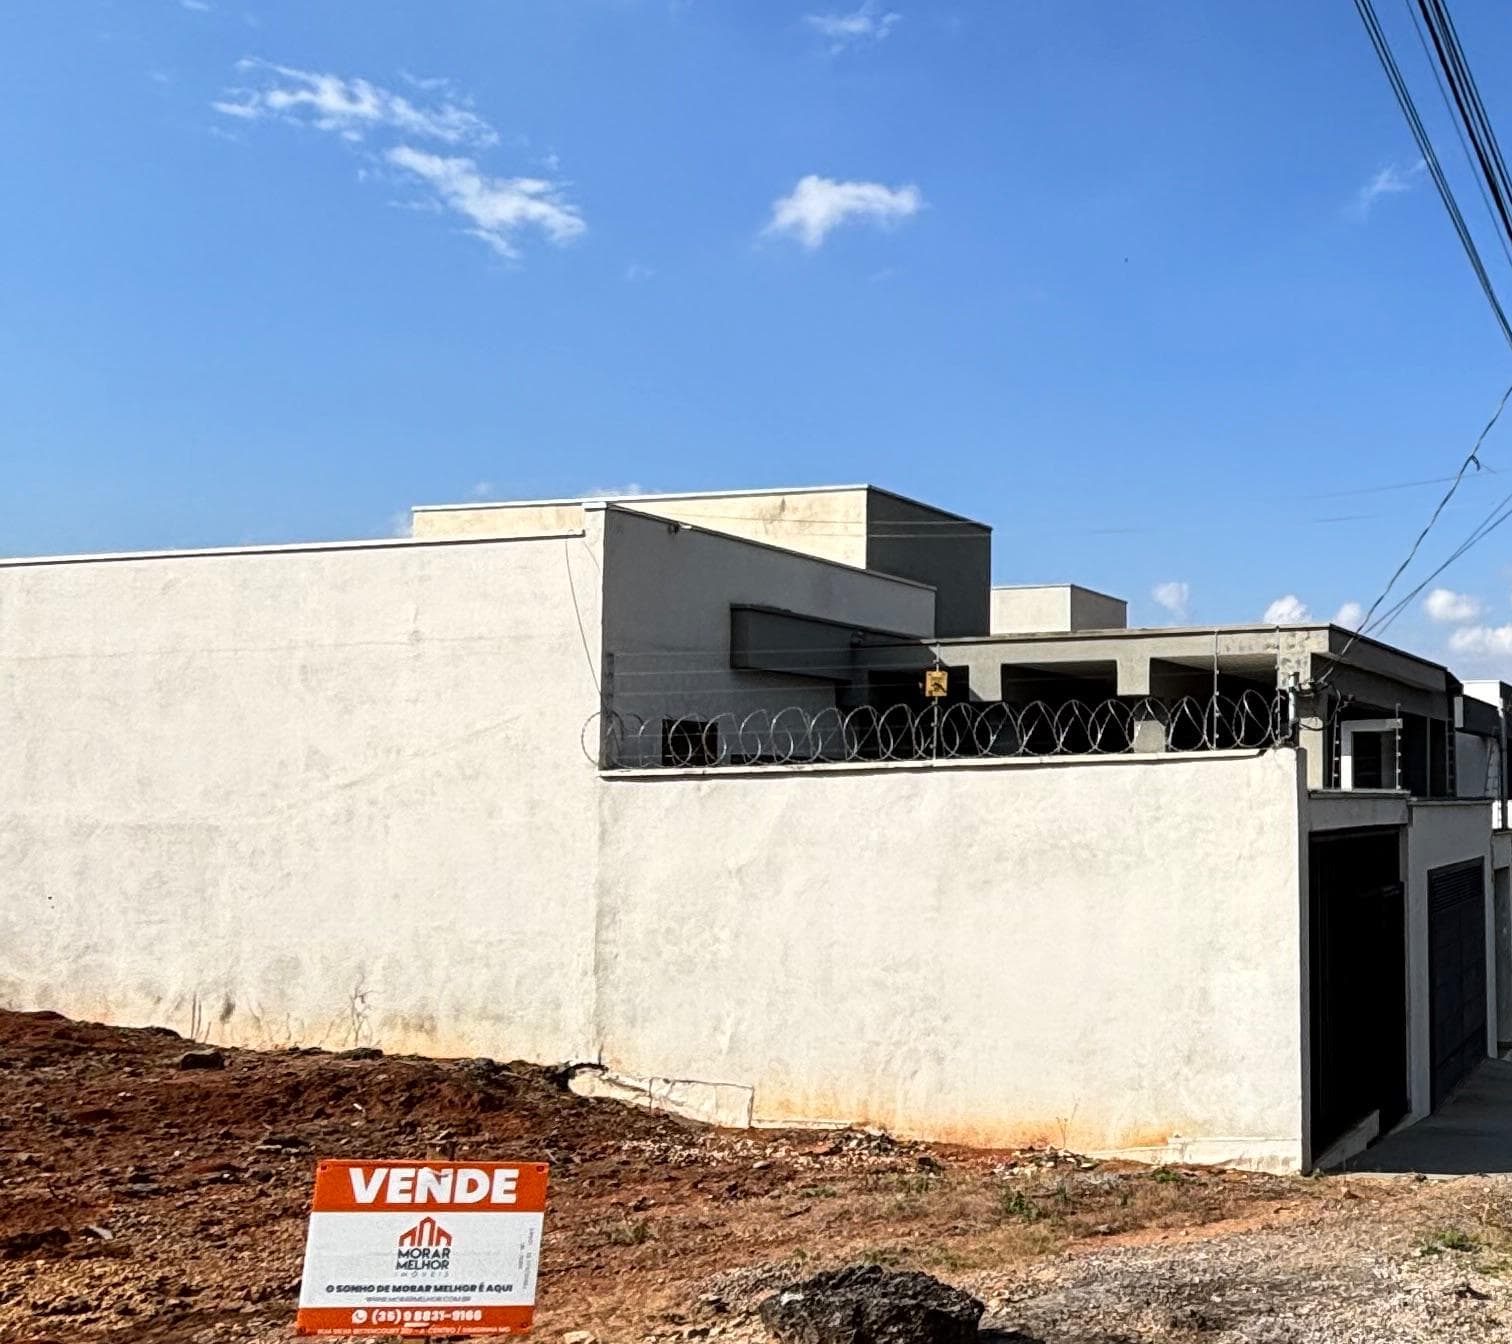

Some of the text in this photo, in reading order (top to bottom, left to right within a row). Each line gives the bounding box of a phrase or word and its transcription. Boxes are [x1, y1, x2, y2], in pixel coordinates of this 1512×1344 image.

[349, 1167, 519, 1204] VENDE
[397, 1248, 451, 1259] MORAR
[396, 1259, 450, 1270] MELHOR
[326, 1282, 513, 1293] O SONHO DE MORAR MELHOR É AQUI
